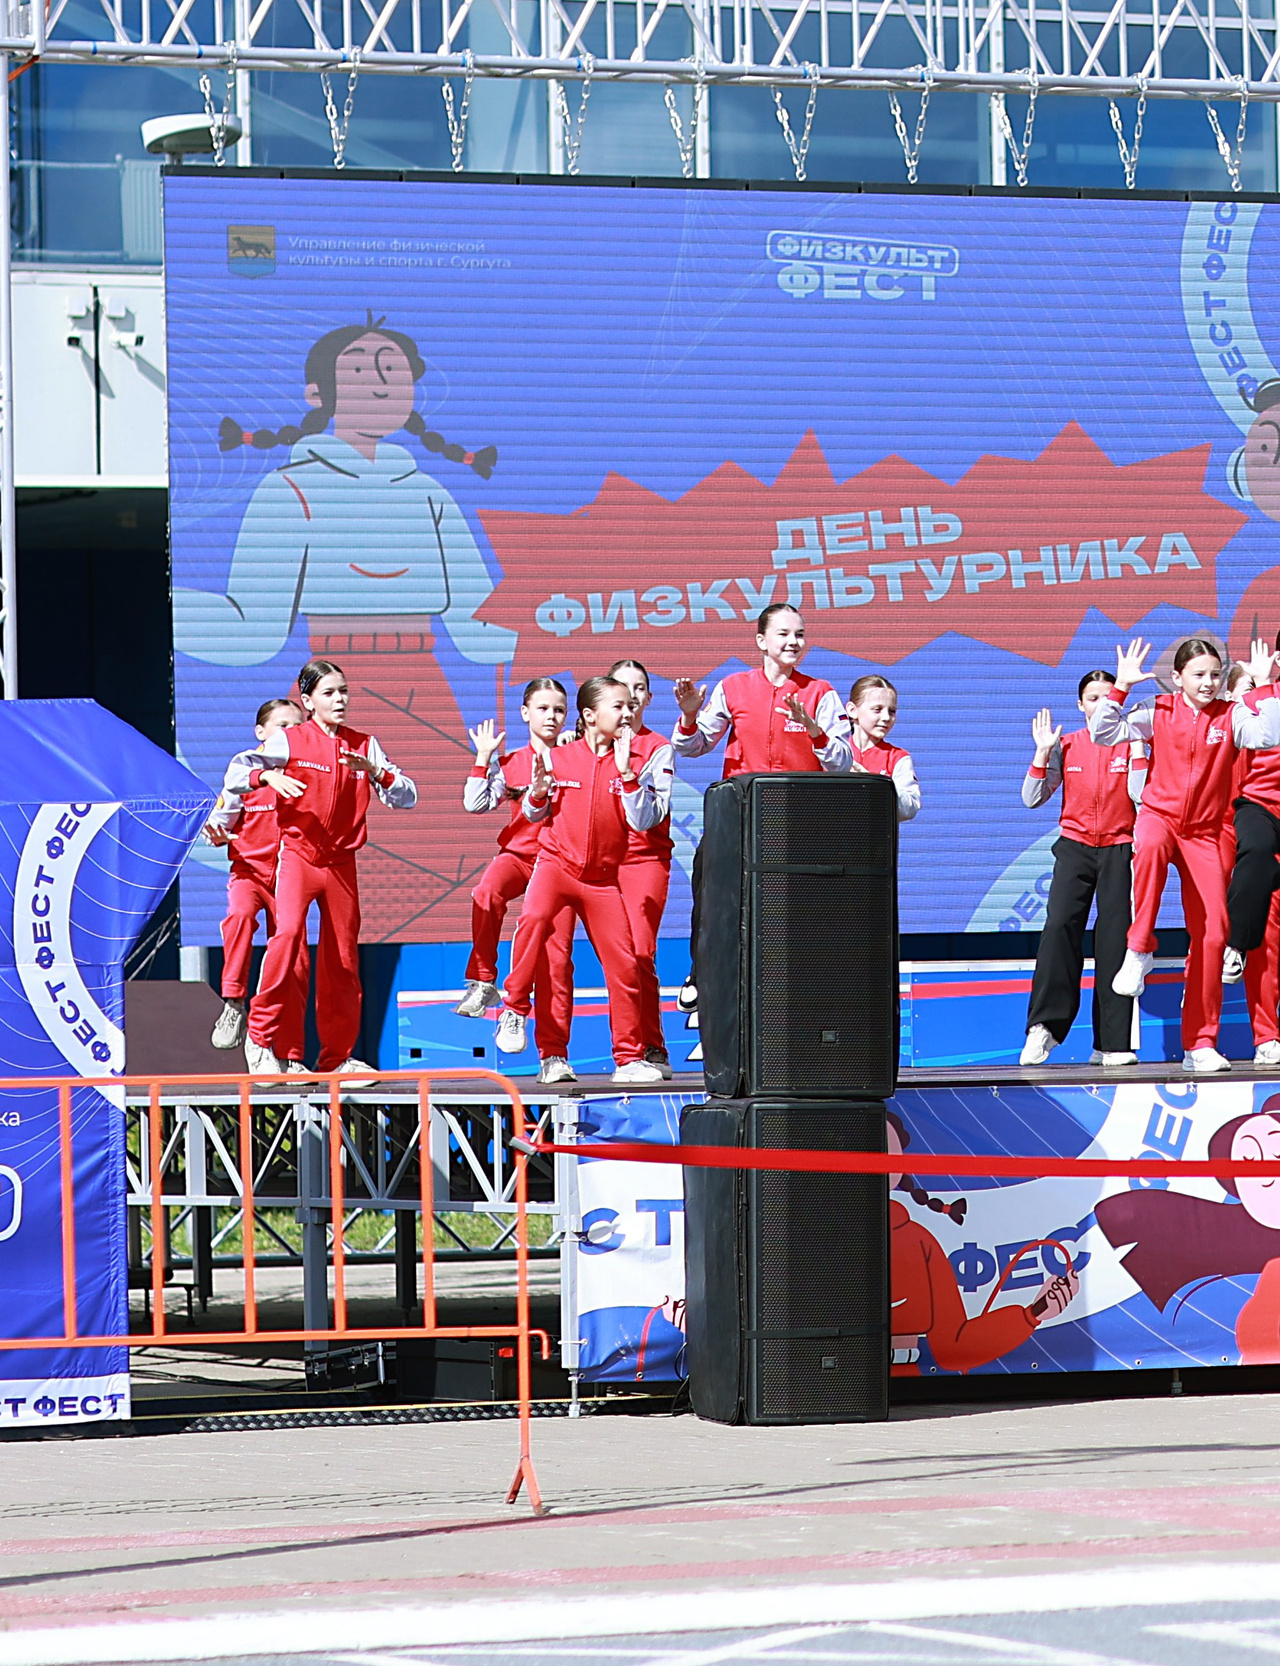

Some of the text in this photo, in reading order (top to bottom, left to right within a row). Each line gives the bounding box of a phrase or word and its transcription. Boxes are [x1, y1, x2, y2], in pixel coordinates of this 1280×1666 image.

[288, 236, 486, 254] Управление физической
[288, 255, 361, 267] культуры
[378, 256, 433, 269] спорта
[450, 255, 511, 271] Сургута
[777, 236, 950, 269] ФИЗКУЛЬТ
[777, 262, 936, 301] ФЕСТ
[1202, 290, 1259, 399] ФЕСТ
[771, 505, 963, 569] ДЕНЬ
[535, 532, 1203, 638] ФИЗКУЛЬТУРНИКА
[31, 865, 56, 970] ФЕСТ
[45, 978, 112, 1063] ФЕСТ
[33, 1393, 125, 1417] ФЕСТ
